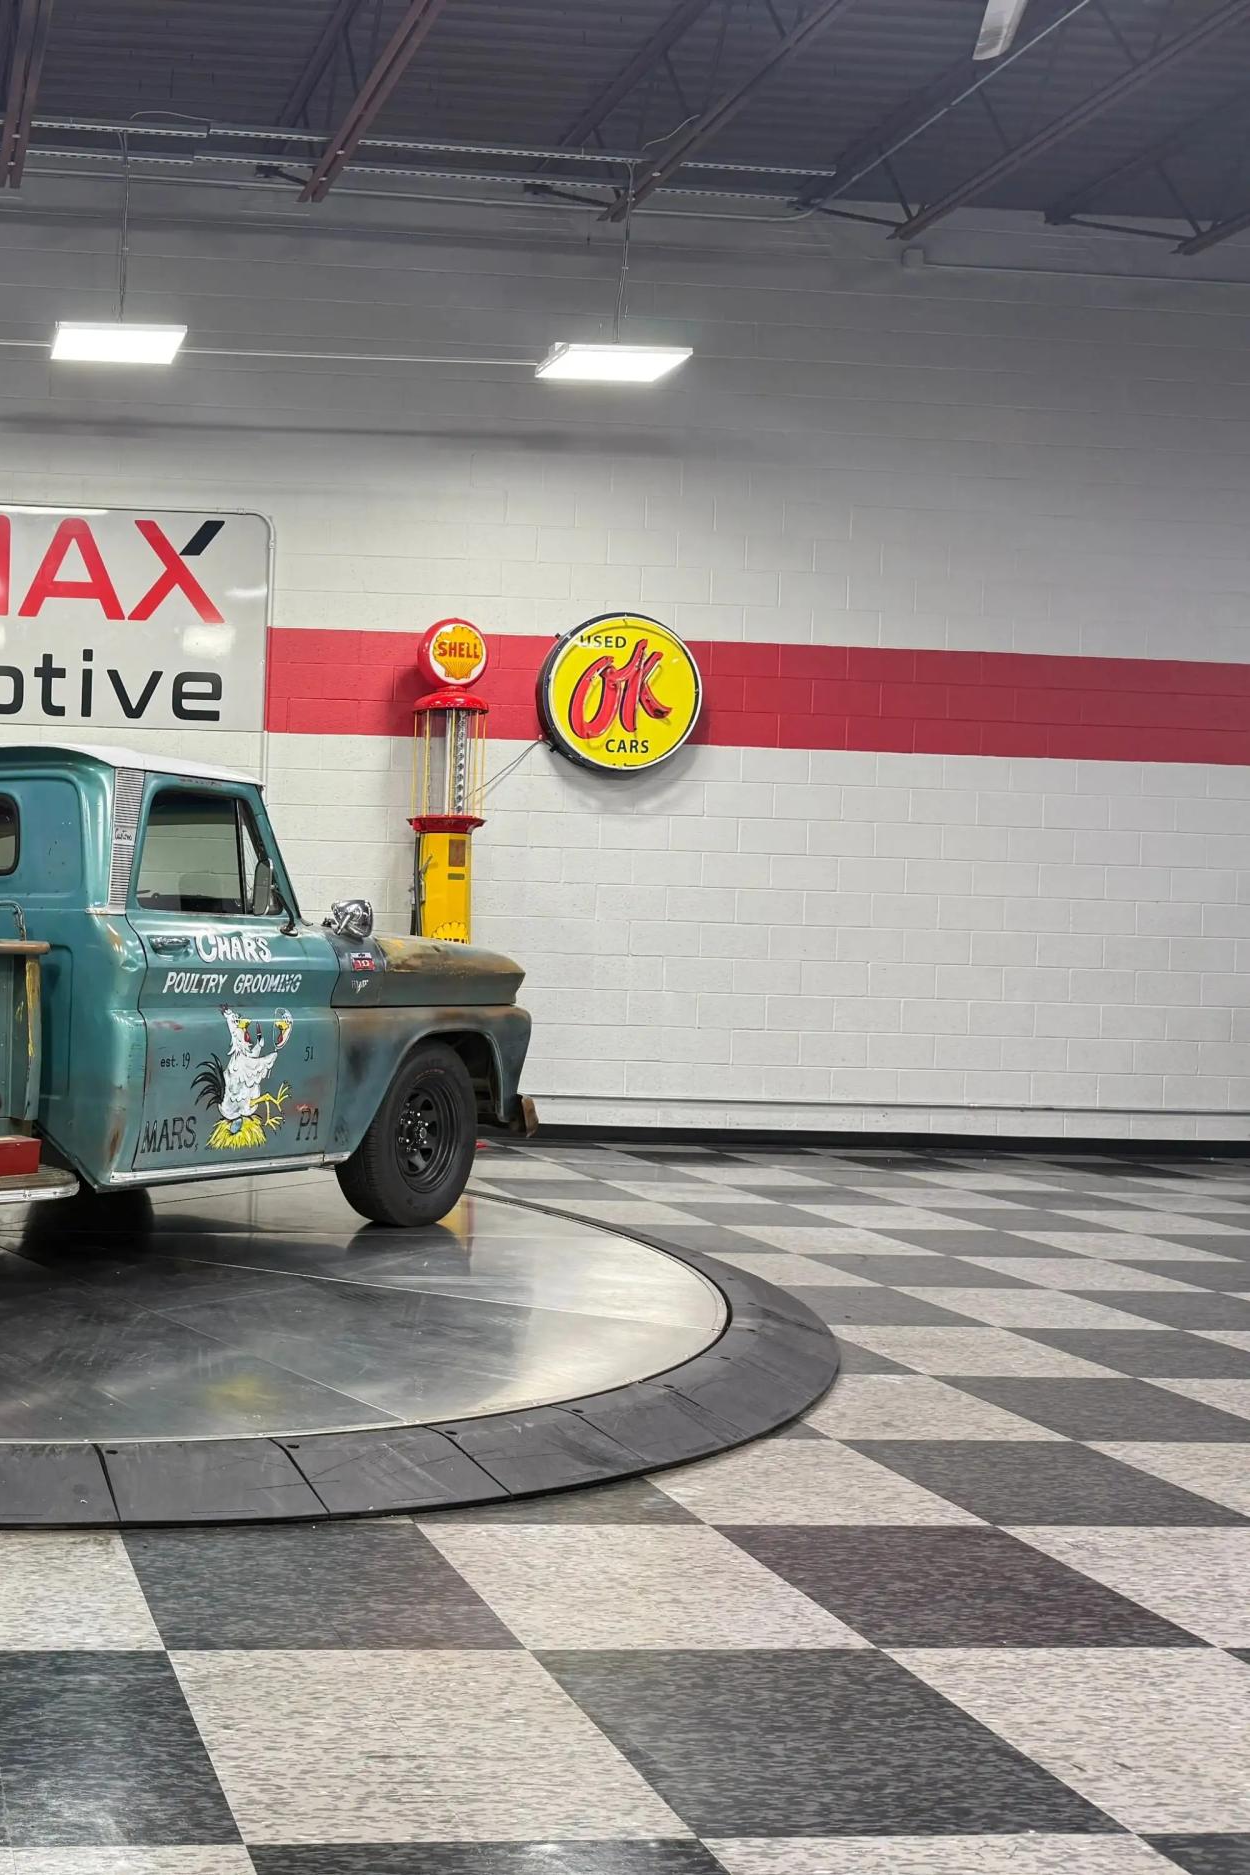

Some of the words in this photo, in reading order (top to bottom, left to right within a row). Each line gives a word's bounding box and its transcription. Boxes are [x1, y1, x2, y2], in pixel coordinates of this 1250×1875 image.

[437, 641, 480, 659] SHELL
[580, 634, 627, 649] USED
[568, 638, 672, 740] OK
[605, 738, 649, 754] CARS
[195, 930, 272, 963] CHARS
[162, 971, 228, 994] POULTRY
[233, 973, 302, 994] GROOMING
[160, 1056, 179, 1068] est.
[181, 1052, 191, 1070] 19
[303, 1046, 314, 1062] 51
[295, 1108, 319, 1141] PA
